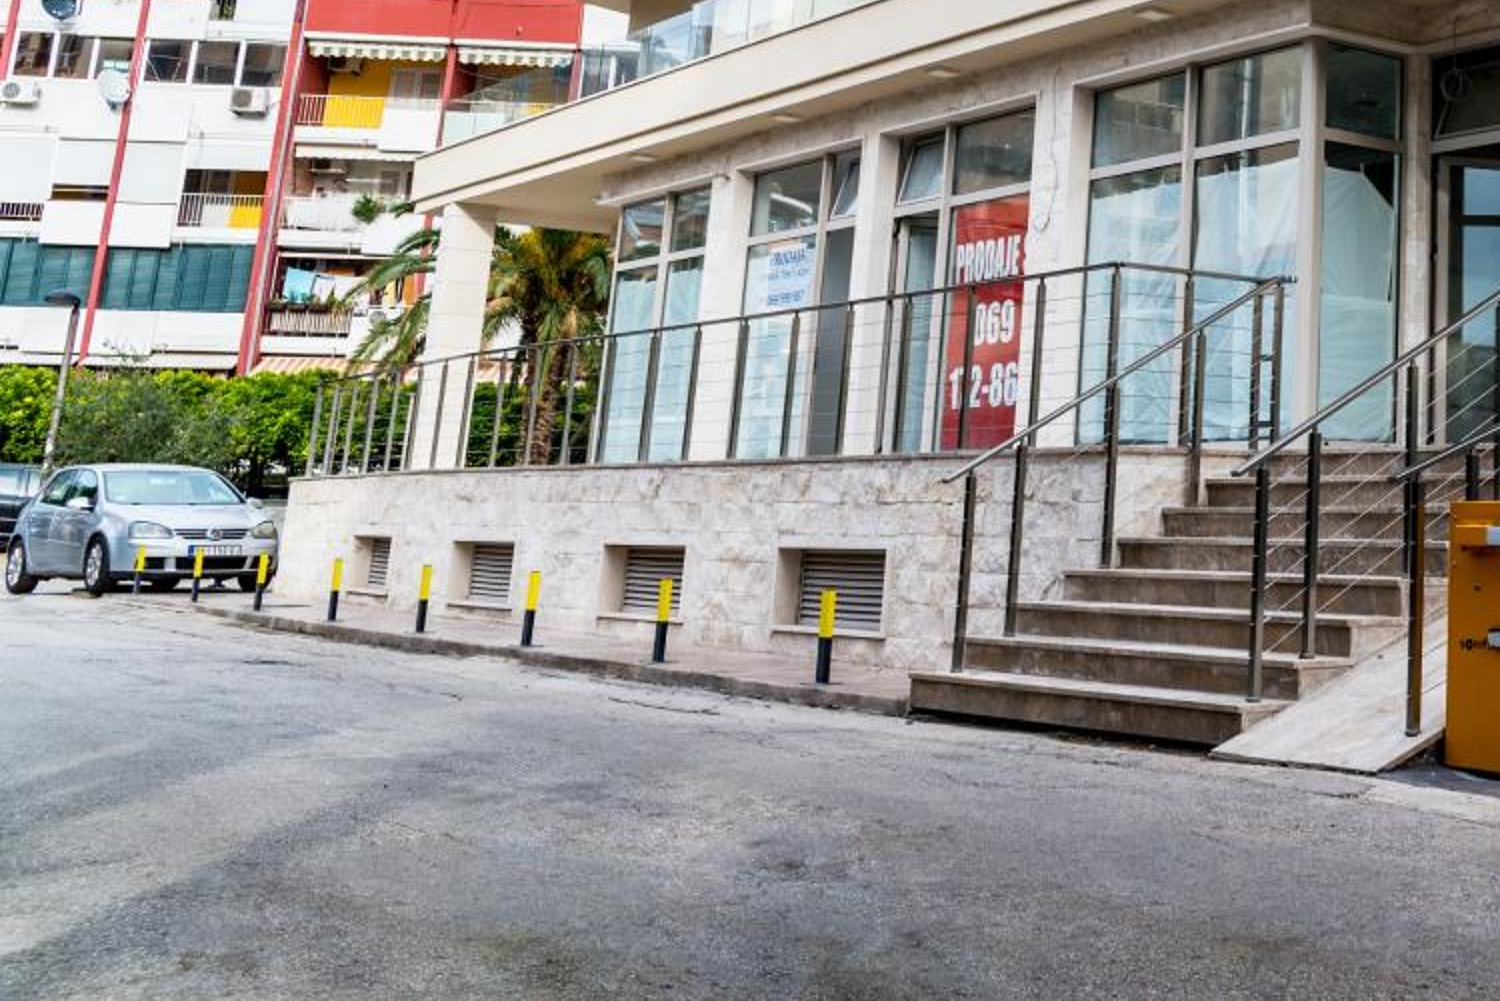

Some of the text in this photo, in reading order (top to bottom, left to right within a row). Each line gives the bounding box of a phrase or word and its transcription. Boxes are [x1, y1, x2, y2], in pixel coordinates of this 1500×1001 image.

[956, 233, 1021, 285] PRODAJE
[974, 299, 1015, 346] 069
[949, 362, 1018, 410] 12-86
